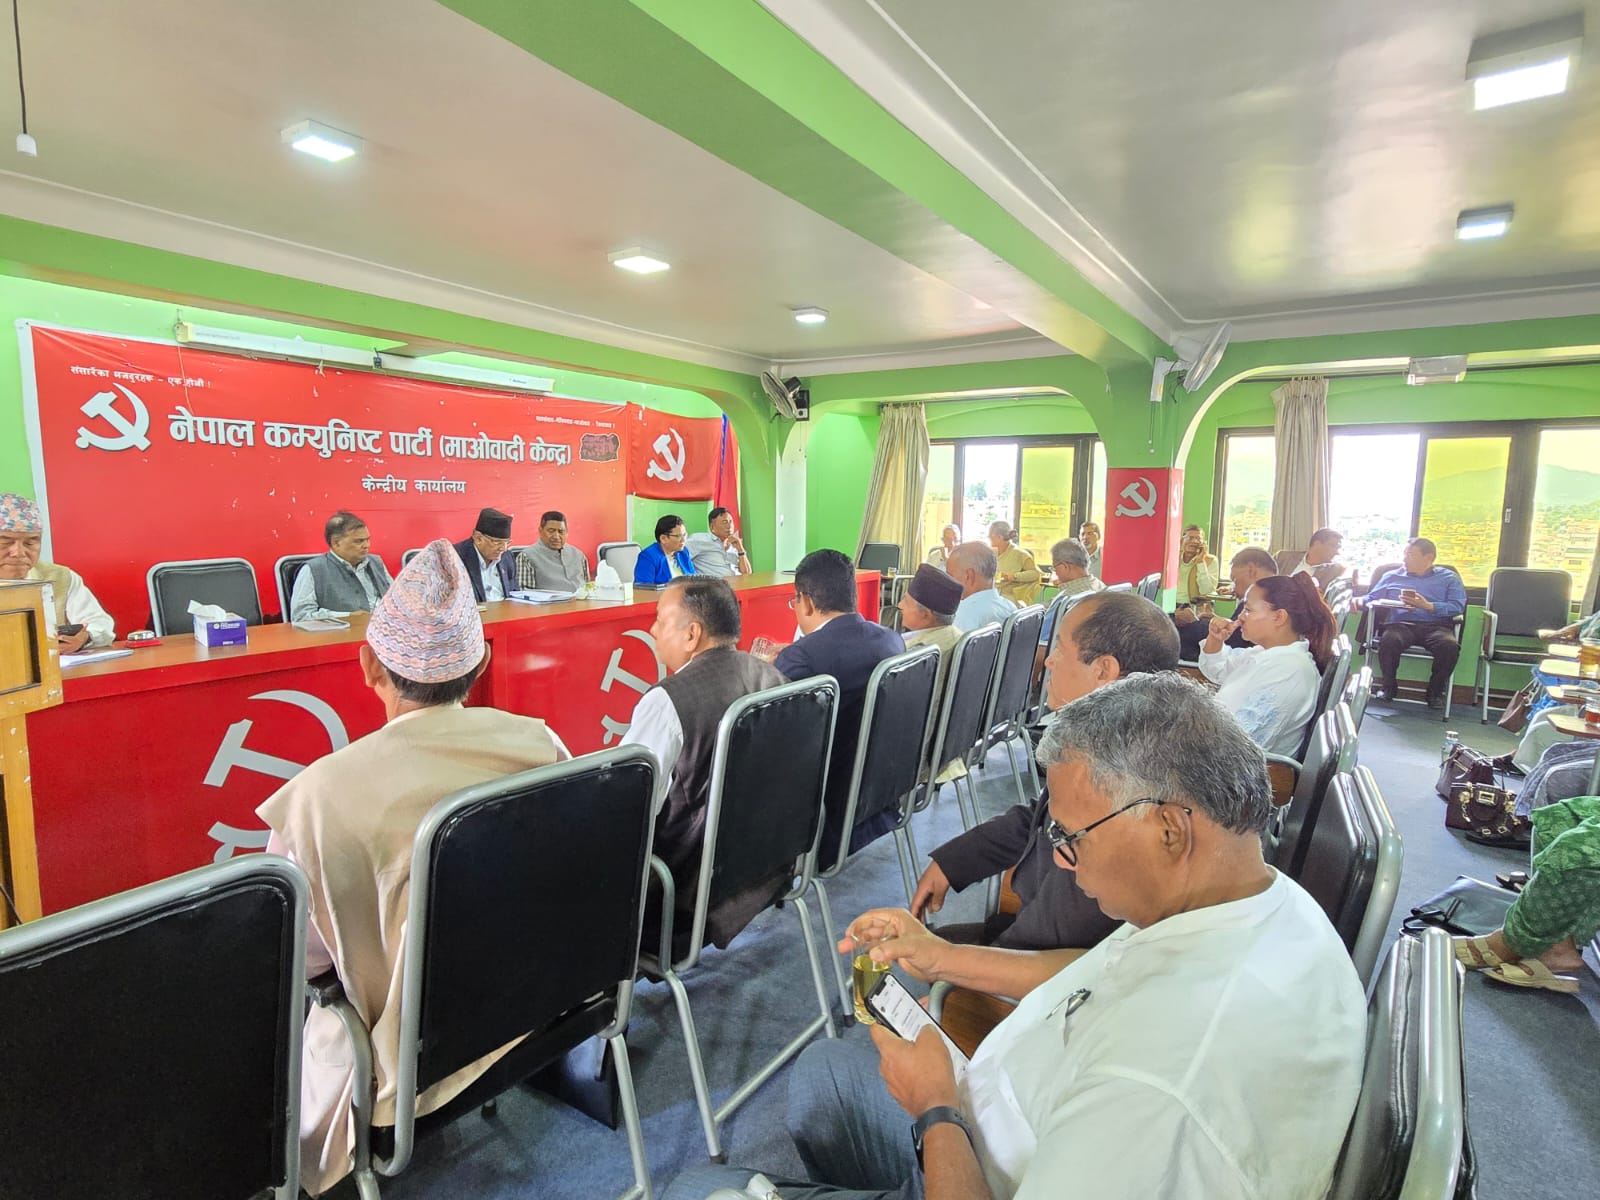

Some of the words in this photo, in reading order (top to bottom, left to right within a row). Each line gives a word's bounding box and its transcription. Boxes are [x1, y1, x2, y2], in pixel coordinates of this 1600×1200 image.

[167, 405, 255, 447] नेपाल
[263, 418, 383, 459] कम्युनिष्ट
[389, 427, 433, 457] पार्टी
[439, 431, 526, 463] (माओवादी
[529, 436, 572, 466] केन्द्र)
[361, 474, 407, 493] केन्द्रीय
[414, 476, 467, 494] कार्यालय
